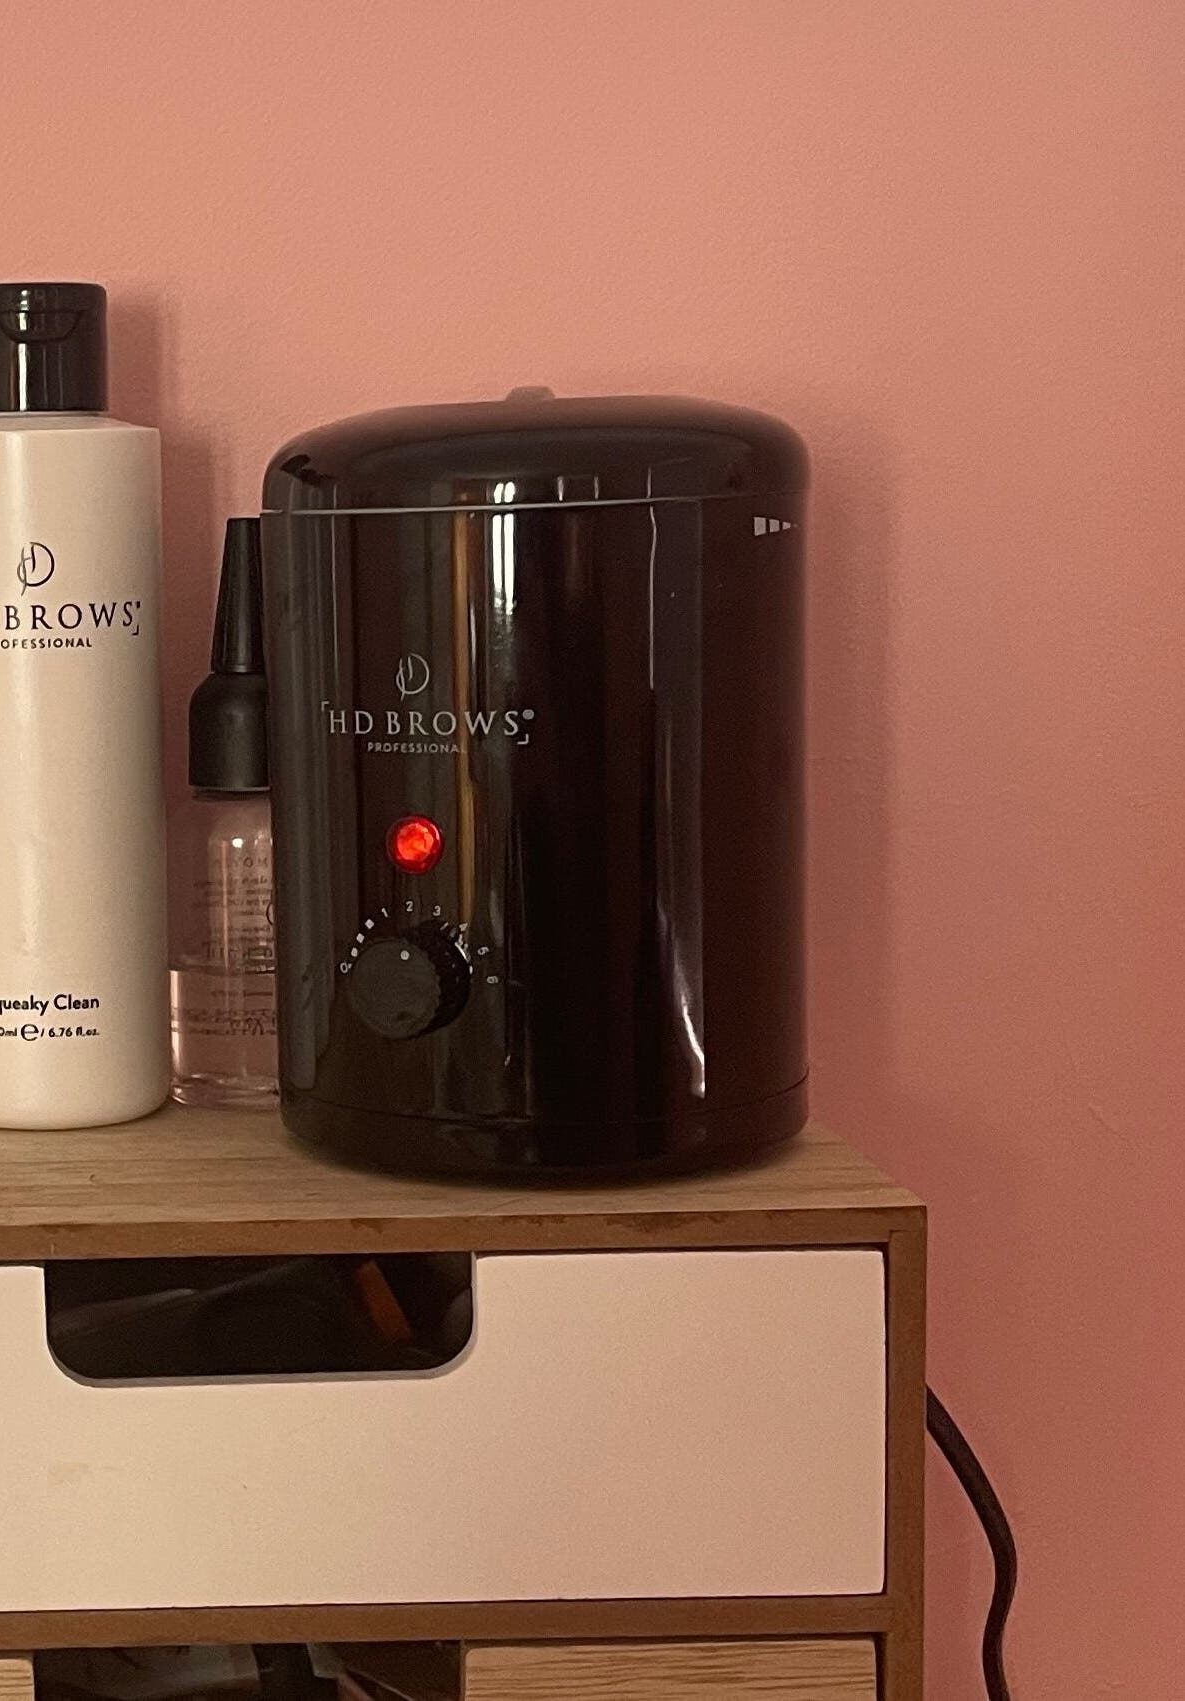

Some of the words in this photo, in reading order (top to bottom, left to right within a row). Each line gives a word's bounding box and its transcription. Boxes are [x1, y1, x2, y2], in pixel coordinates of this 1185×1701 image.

[5, 601, 133, 630] BROWS
[329, 709, 374, 735] HD
[386, 709, 519, 736] BROWS
[367, 741, 465, 754] PROFESSIONAL
[381, 907, 389, 918] 1
[406, 901, 413, 912] 2
[432, 905, 441, 916] 3
[54, 994, 100, 1010] Clean
